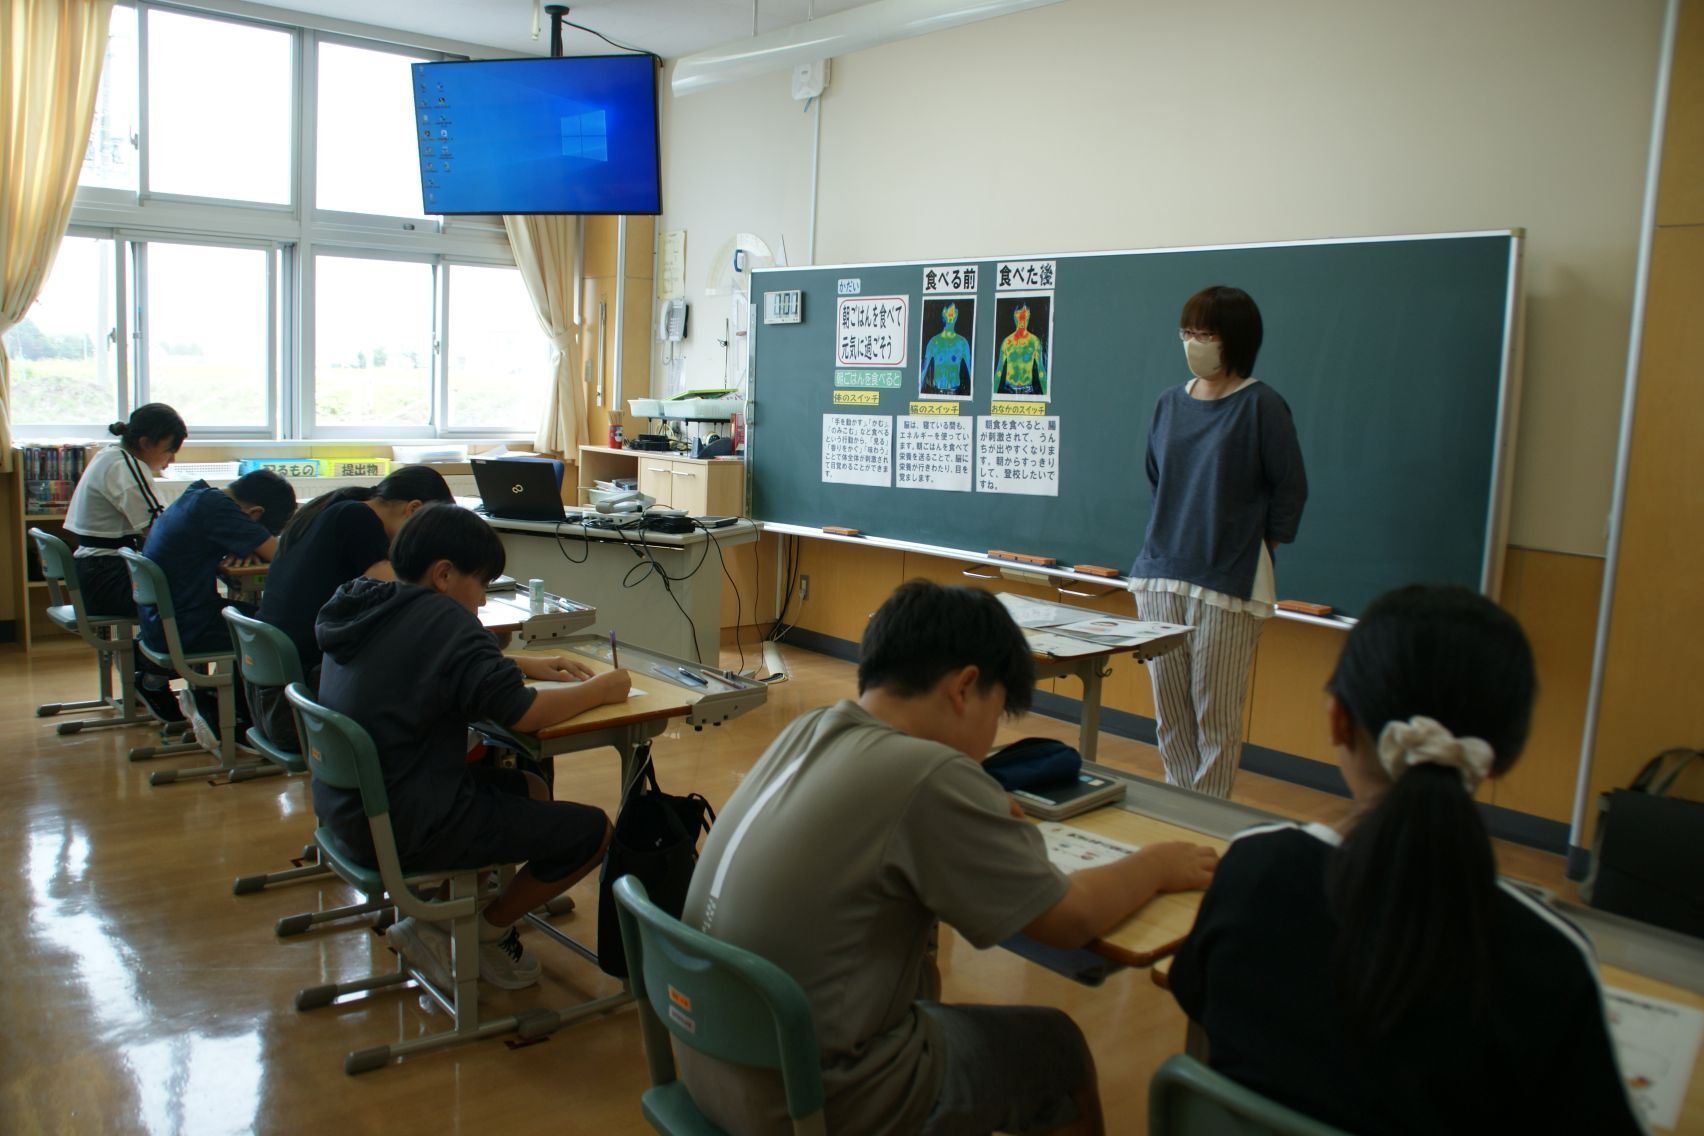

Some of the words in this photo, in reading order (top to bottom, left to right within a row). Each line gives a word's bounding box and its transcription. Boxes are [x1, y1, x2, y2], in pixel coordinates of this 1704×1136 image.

[925, 268, 976, 291] 食べる前
[999, 262, 1053, 287] 食べた後
[839, 281, 859, 292] かだい
[842, 303, 902, 330] 朝ごはんを食べて
[842, 333, 892, 360] 元気に過ごそう
[836, 372, 900, 386] 朝ごはんを食べると
[834, 394, 880, 403] 体のスイッチ
[991, 404, 1045, 414] おなかのスイッチ
[980, 444, 1055, 455] ちが出やすくなりま
[342, 463, 379, 476] 提出物
[979, 480, 998, 490] すね。
